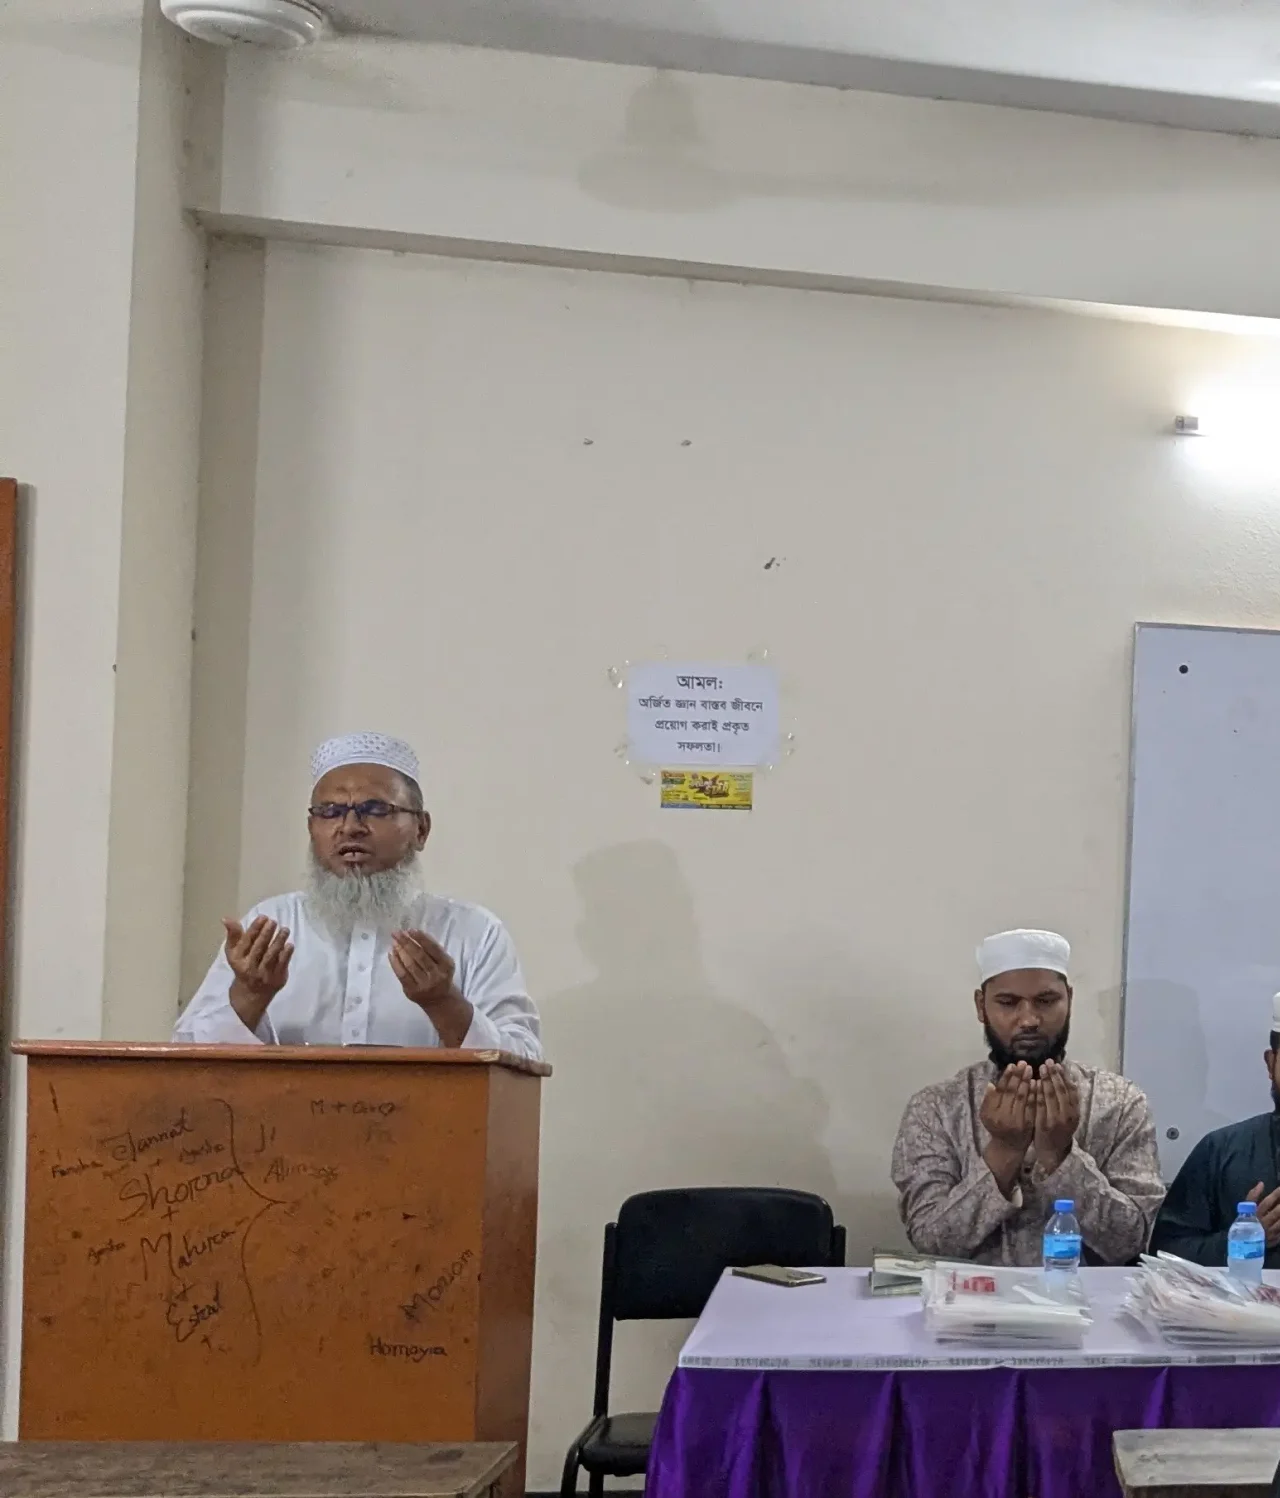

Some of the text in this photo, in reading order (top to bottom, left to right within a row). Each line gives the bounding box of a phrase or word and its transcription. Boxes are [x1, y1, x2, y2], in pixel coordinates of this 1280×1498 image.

[638, 696, 763, 712] অর্জিত জ্ঞান বাস্তব জীবনে
[654, 719, 749, 735] প্রয়োগ করাই প্রকৃত
